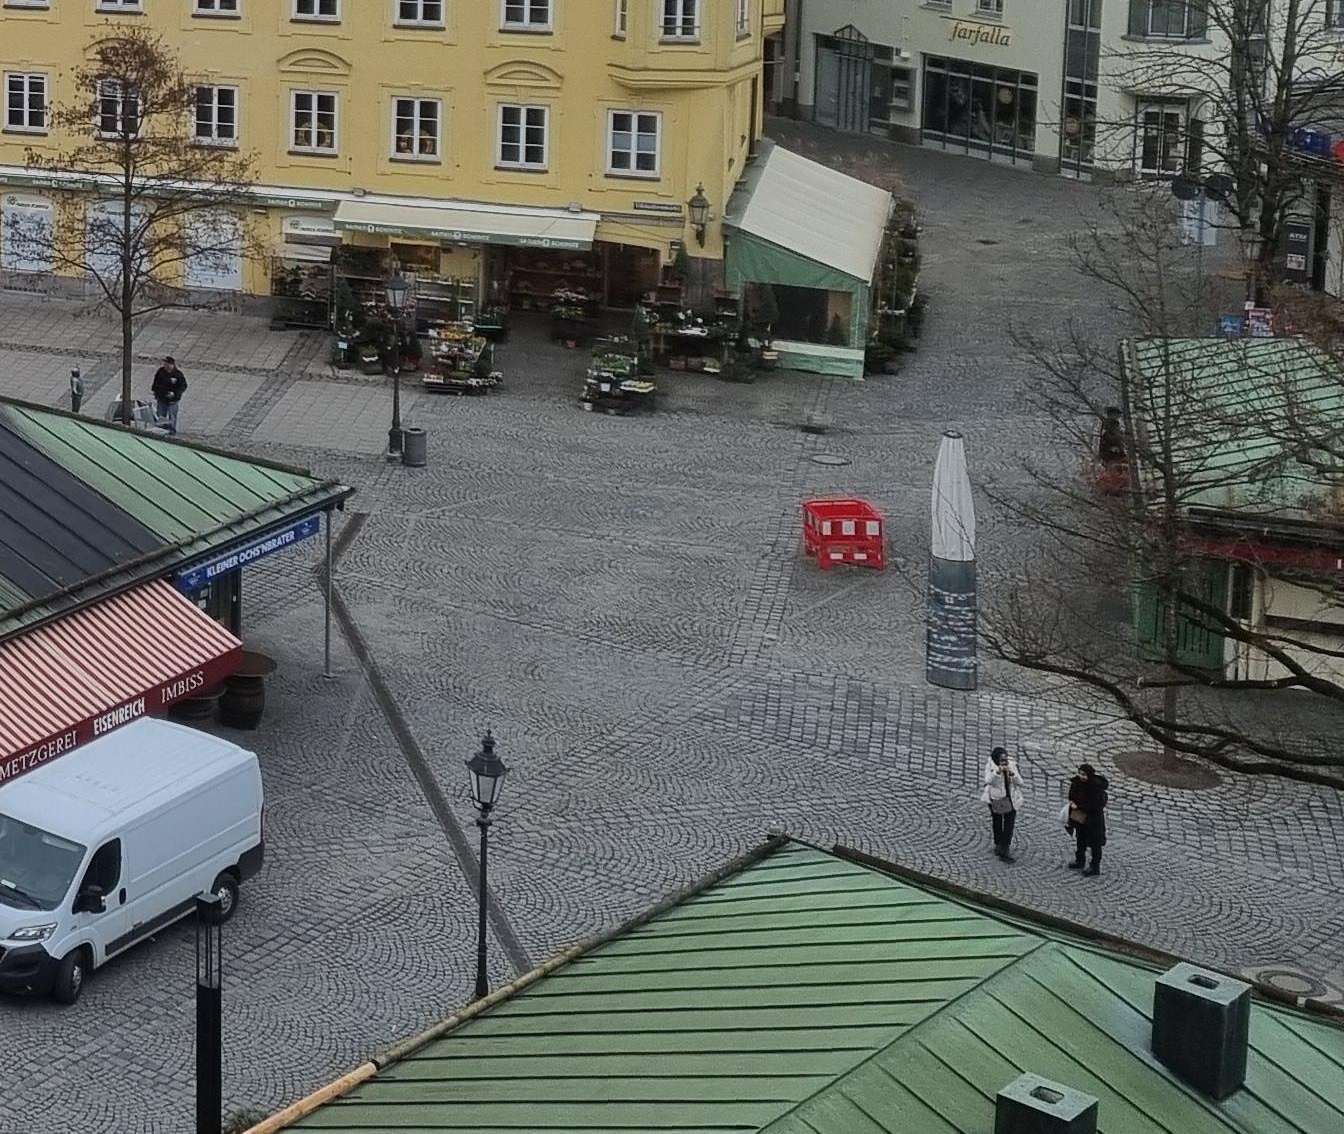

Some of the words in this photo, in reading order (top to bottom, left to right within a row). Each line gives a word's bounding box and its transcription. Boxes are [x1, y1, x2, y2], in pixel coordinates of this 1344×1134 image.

[949, 22, 1009, 46] farfalla
[206, 556, 239, 578] KLEINER
[94, 697, 145, 735] EISENREICH
[162, 671, 204, 703] IMBISS
